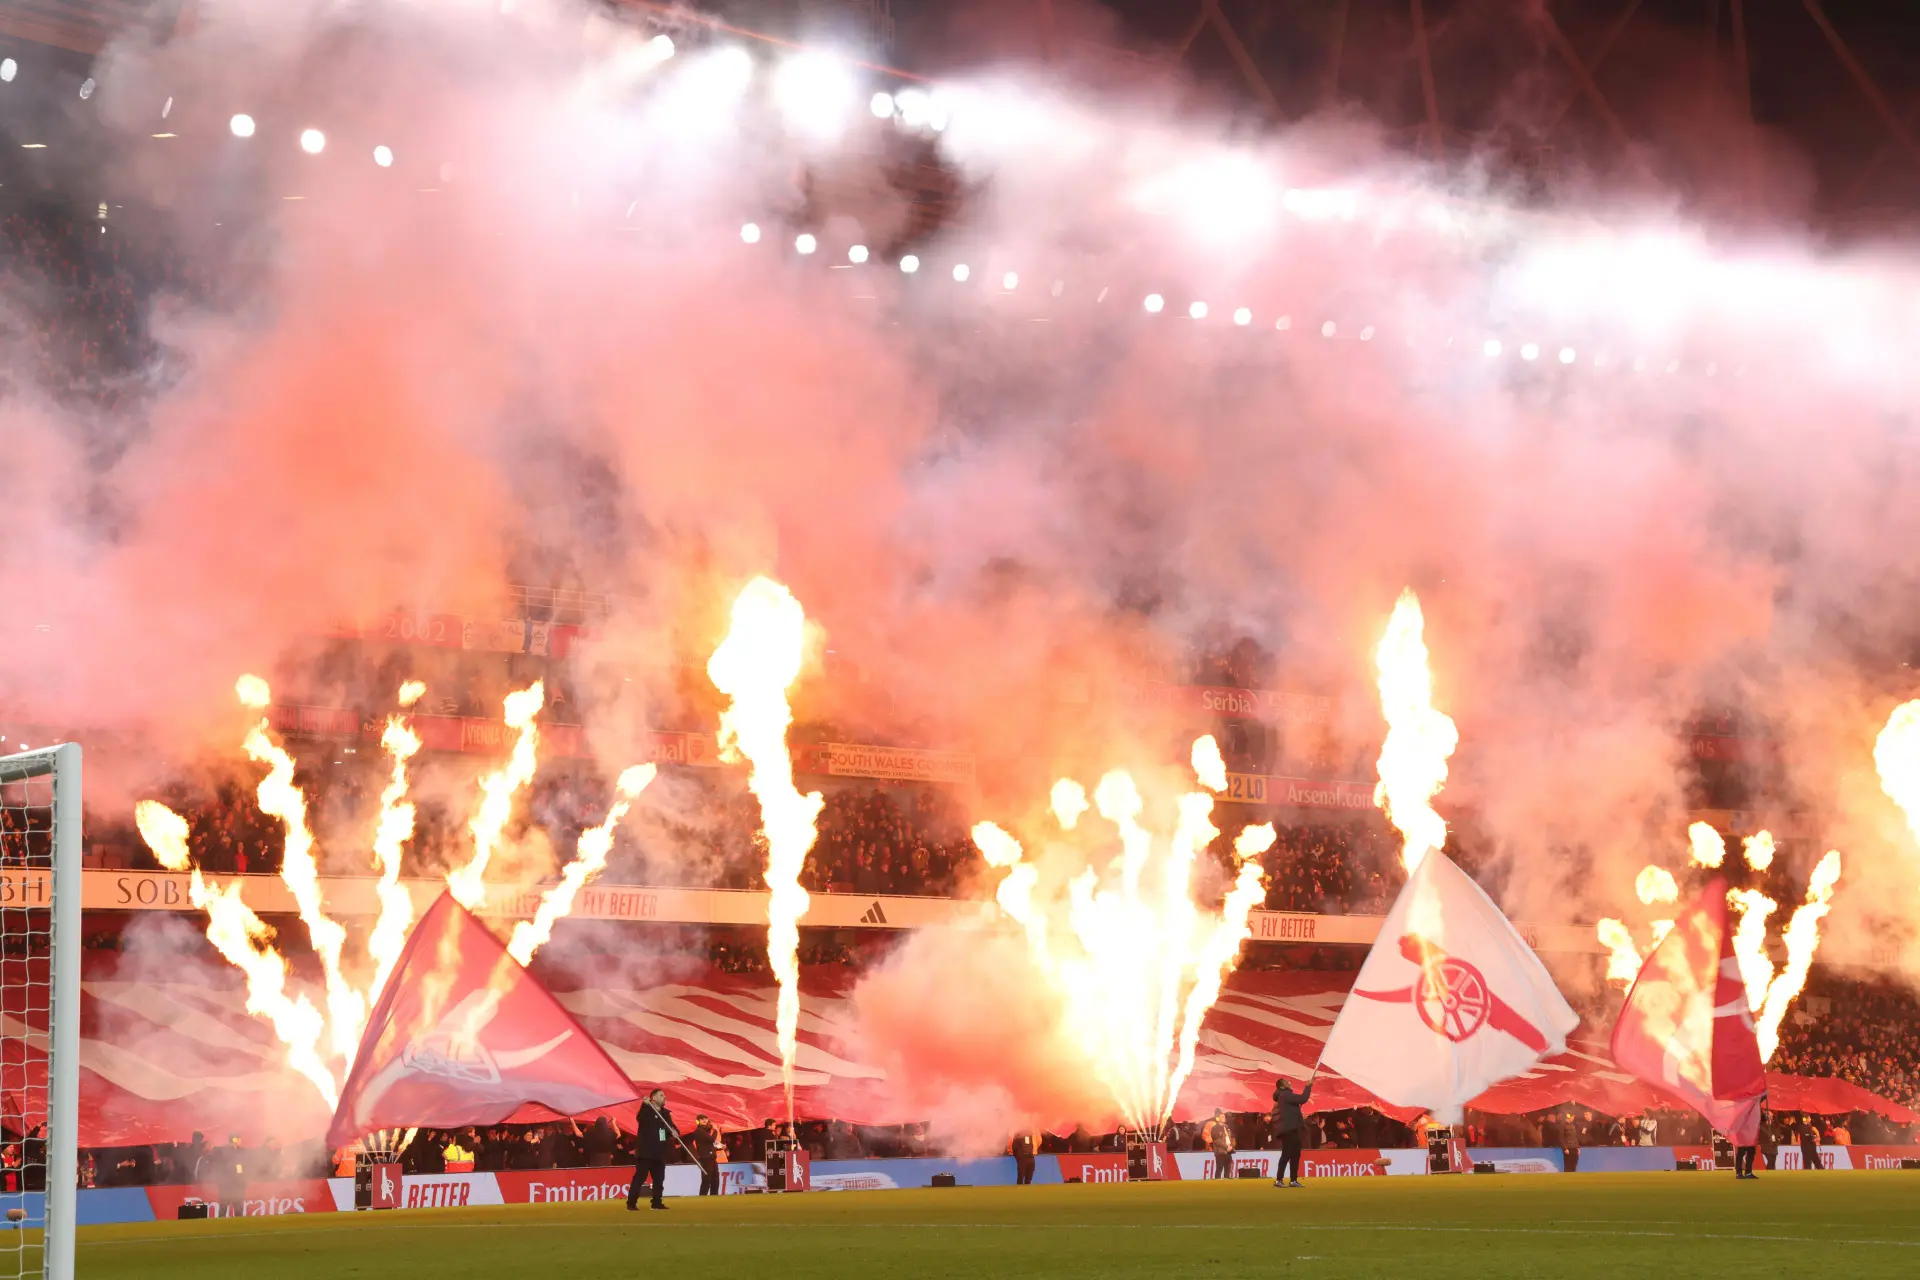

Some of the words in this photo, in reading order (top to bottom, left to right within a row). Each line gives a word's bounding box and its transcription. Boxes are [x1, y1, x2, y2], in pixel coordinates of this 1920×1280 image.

[385, 616, 446, 643] 2002
[1202, 690, 1252, 713] Serbia
[830, 753, 872, 768] SOUTH
[874, 755, 914, 770] WALES
[116, 876, 191, 905] SOB
[583, 891, 606, 915] FLY
[609, 892, 658, 917] BETTER
[1261, 916, 1278, 937] FLY
[1280, 918, 1316, 939] BETTER
[1303, 1157, 1375, 1177] Emirates
[1784, 1152, 1800, 1170] FLY
[1082, 1162, 1128, 1184] Emir
[408, 1182, 471, 1209] BETTER
[528, 1179, 631, 1204] Emirates
